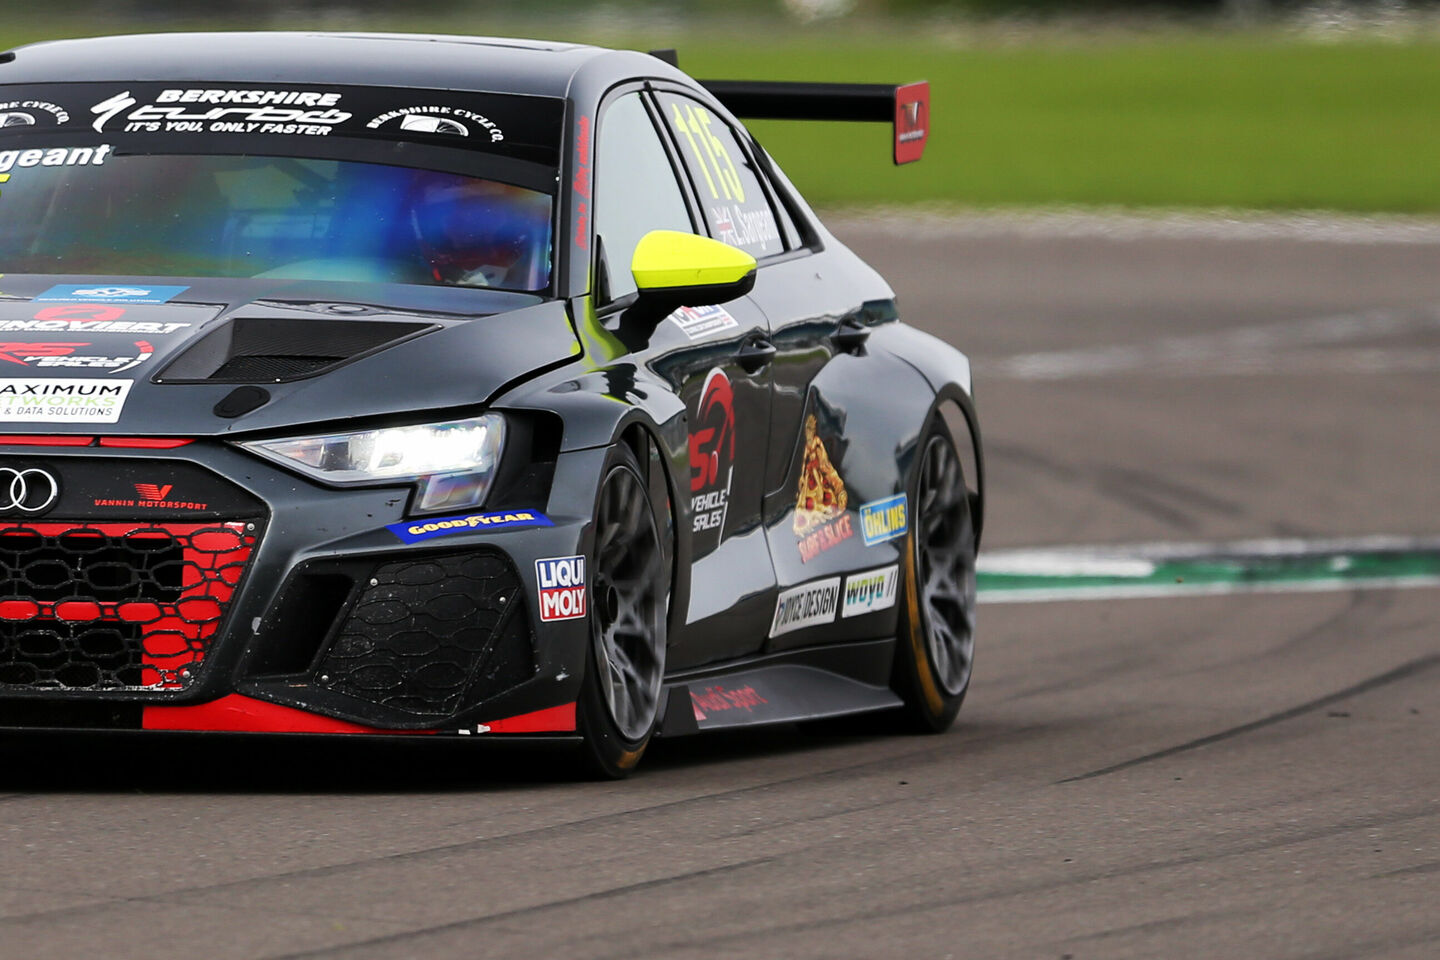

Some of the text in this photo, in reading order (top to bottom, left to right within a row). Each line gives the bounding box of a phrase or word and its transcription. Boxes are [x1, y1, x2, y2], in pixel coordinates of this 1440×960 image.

[156, 90, 342, 107] BERKSHIRE
[366, 106, 451, 129] BERKSHIRE
[453, 108, 497, 129] CYCLE
[124, 122, 332, 136] IT'S YOU, ONLY FASTER
[672, 103, 745, 203] 115
[3, 407, 12, 415] &
[16, 406, 44, 416] DATA
[47, 407, 114, 416] SOLUTIONS
[138, 500, 208, 510] MOTORSPORT
[691, 489, 728, 511] VEHICLE
[408, 512, 535, 535] GOODYEAR
[693, 510, 723, 532] SALES
[539, 558, 584, 588] LIQUI
[542, 588, 586, 618] MOLY
[803, 586, 838, 619] DESIGN
